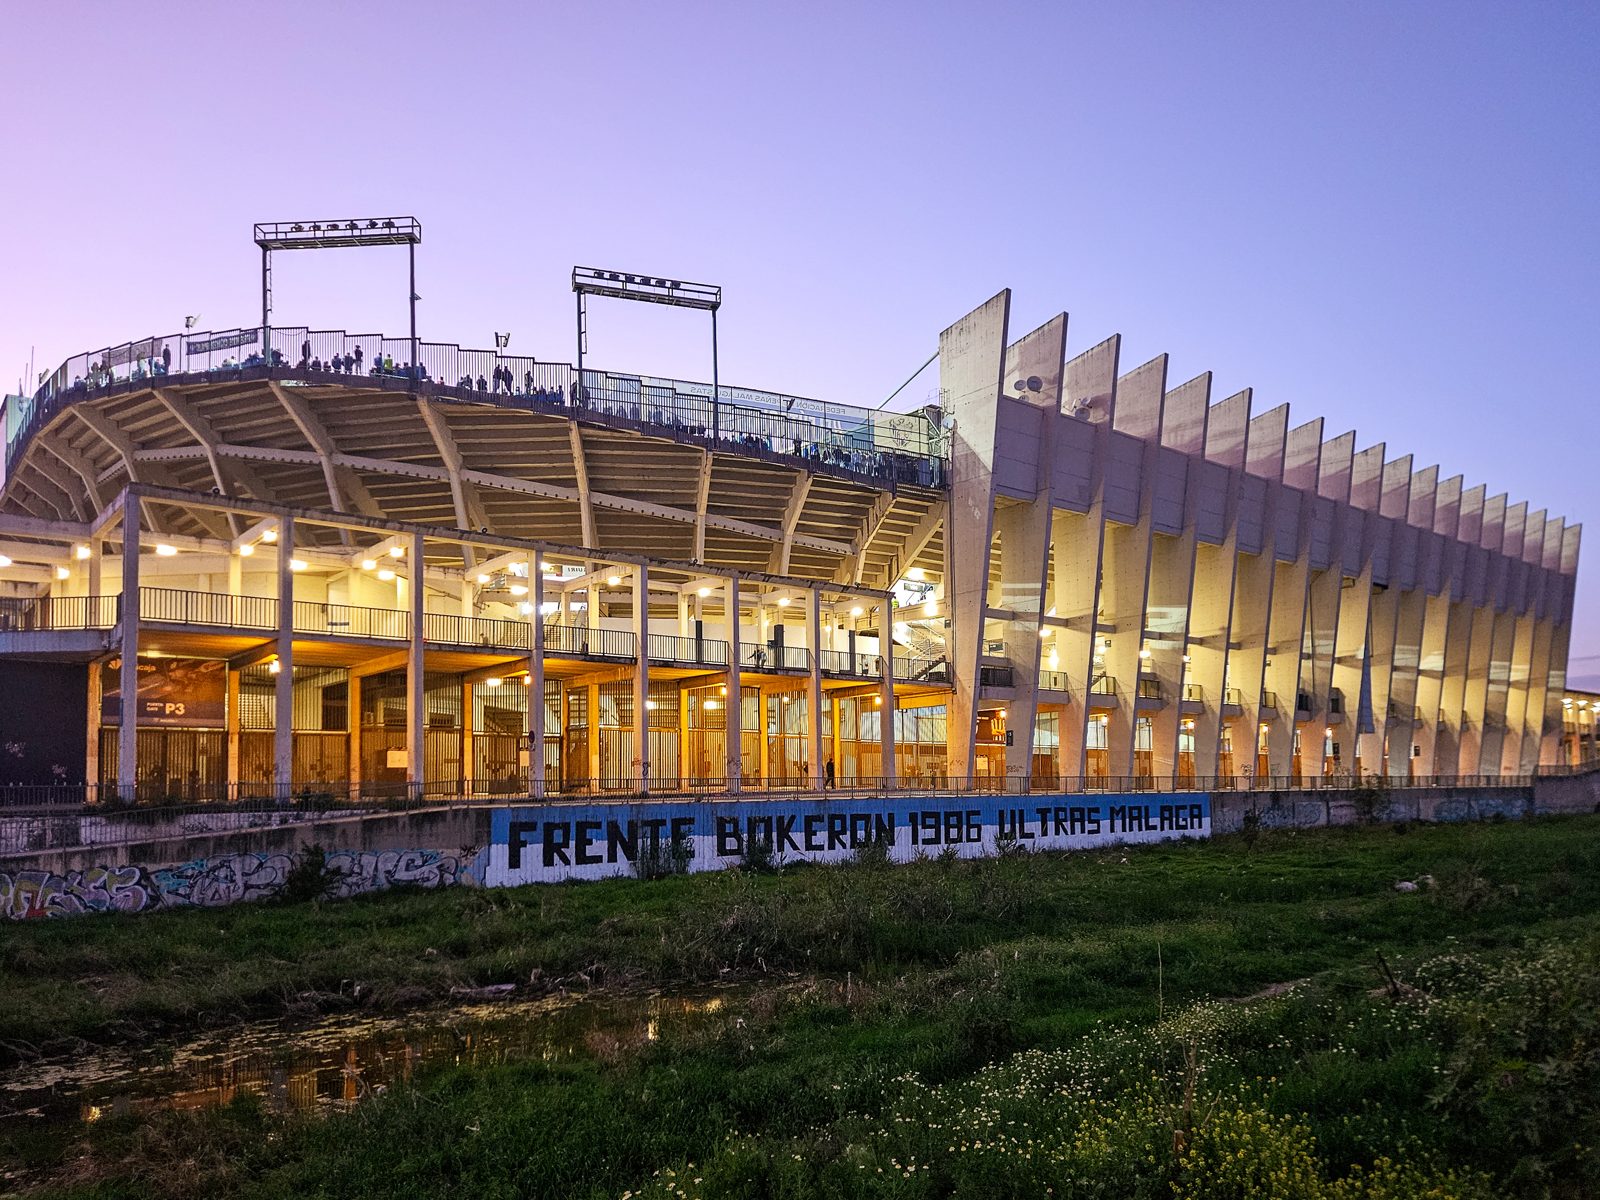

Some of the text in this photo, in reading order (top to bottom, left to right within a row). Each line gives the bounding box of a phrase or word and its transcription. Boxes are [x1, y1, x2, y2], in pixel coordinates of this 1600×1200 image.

[166, 703, 185, 715] P3
[508, 804, 1203, 869] FRENTE BOKERON 1986 ULTRAS MALAGA
